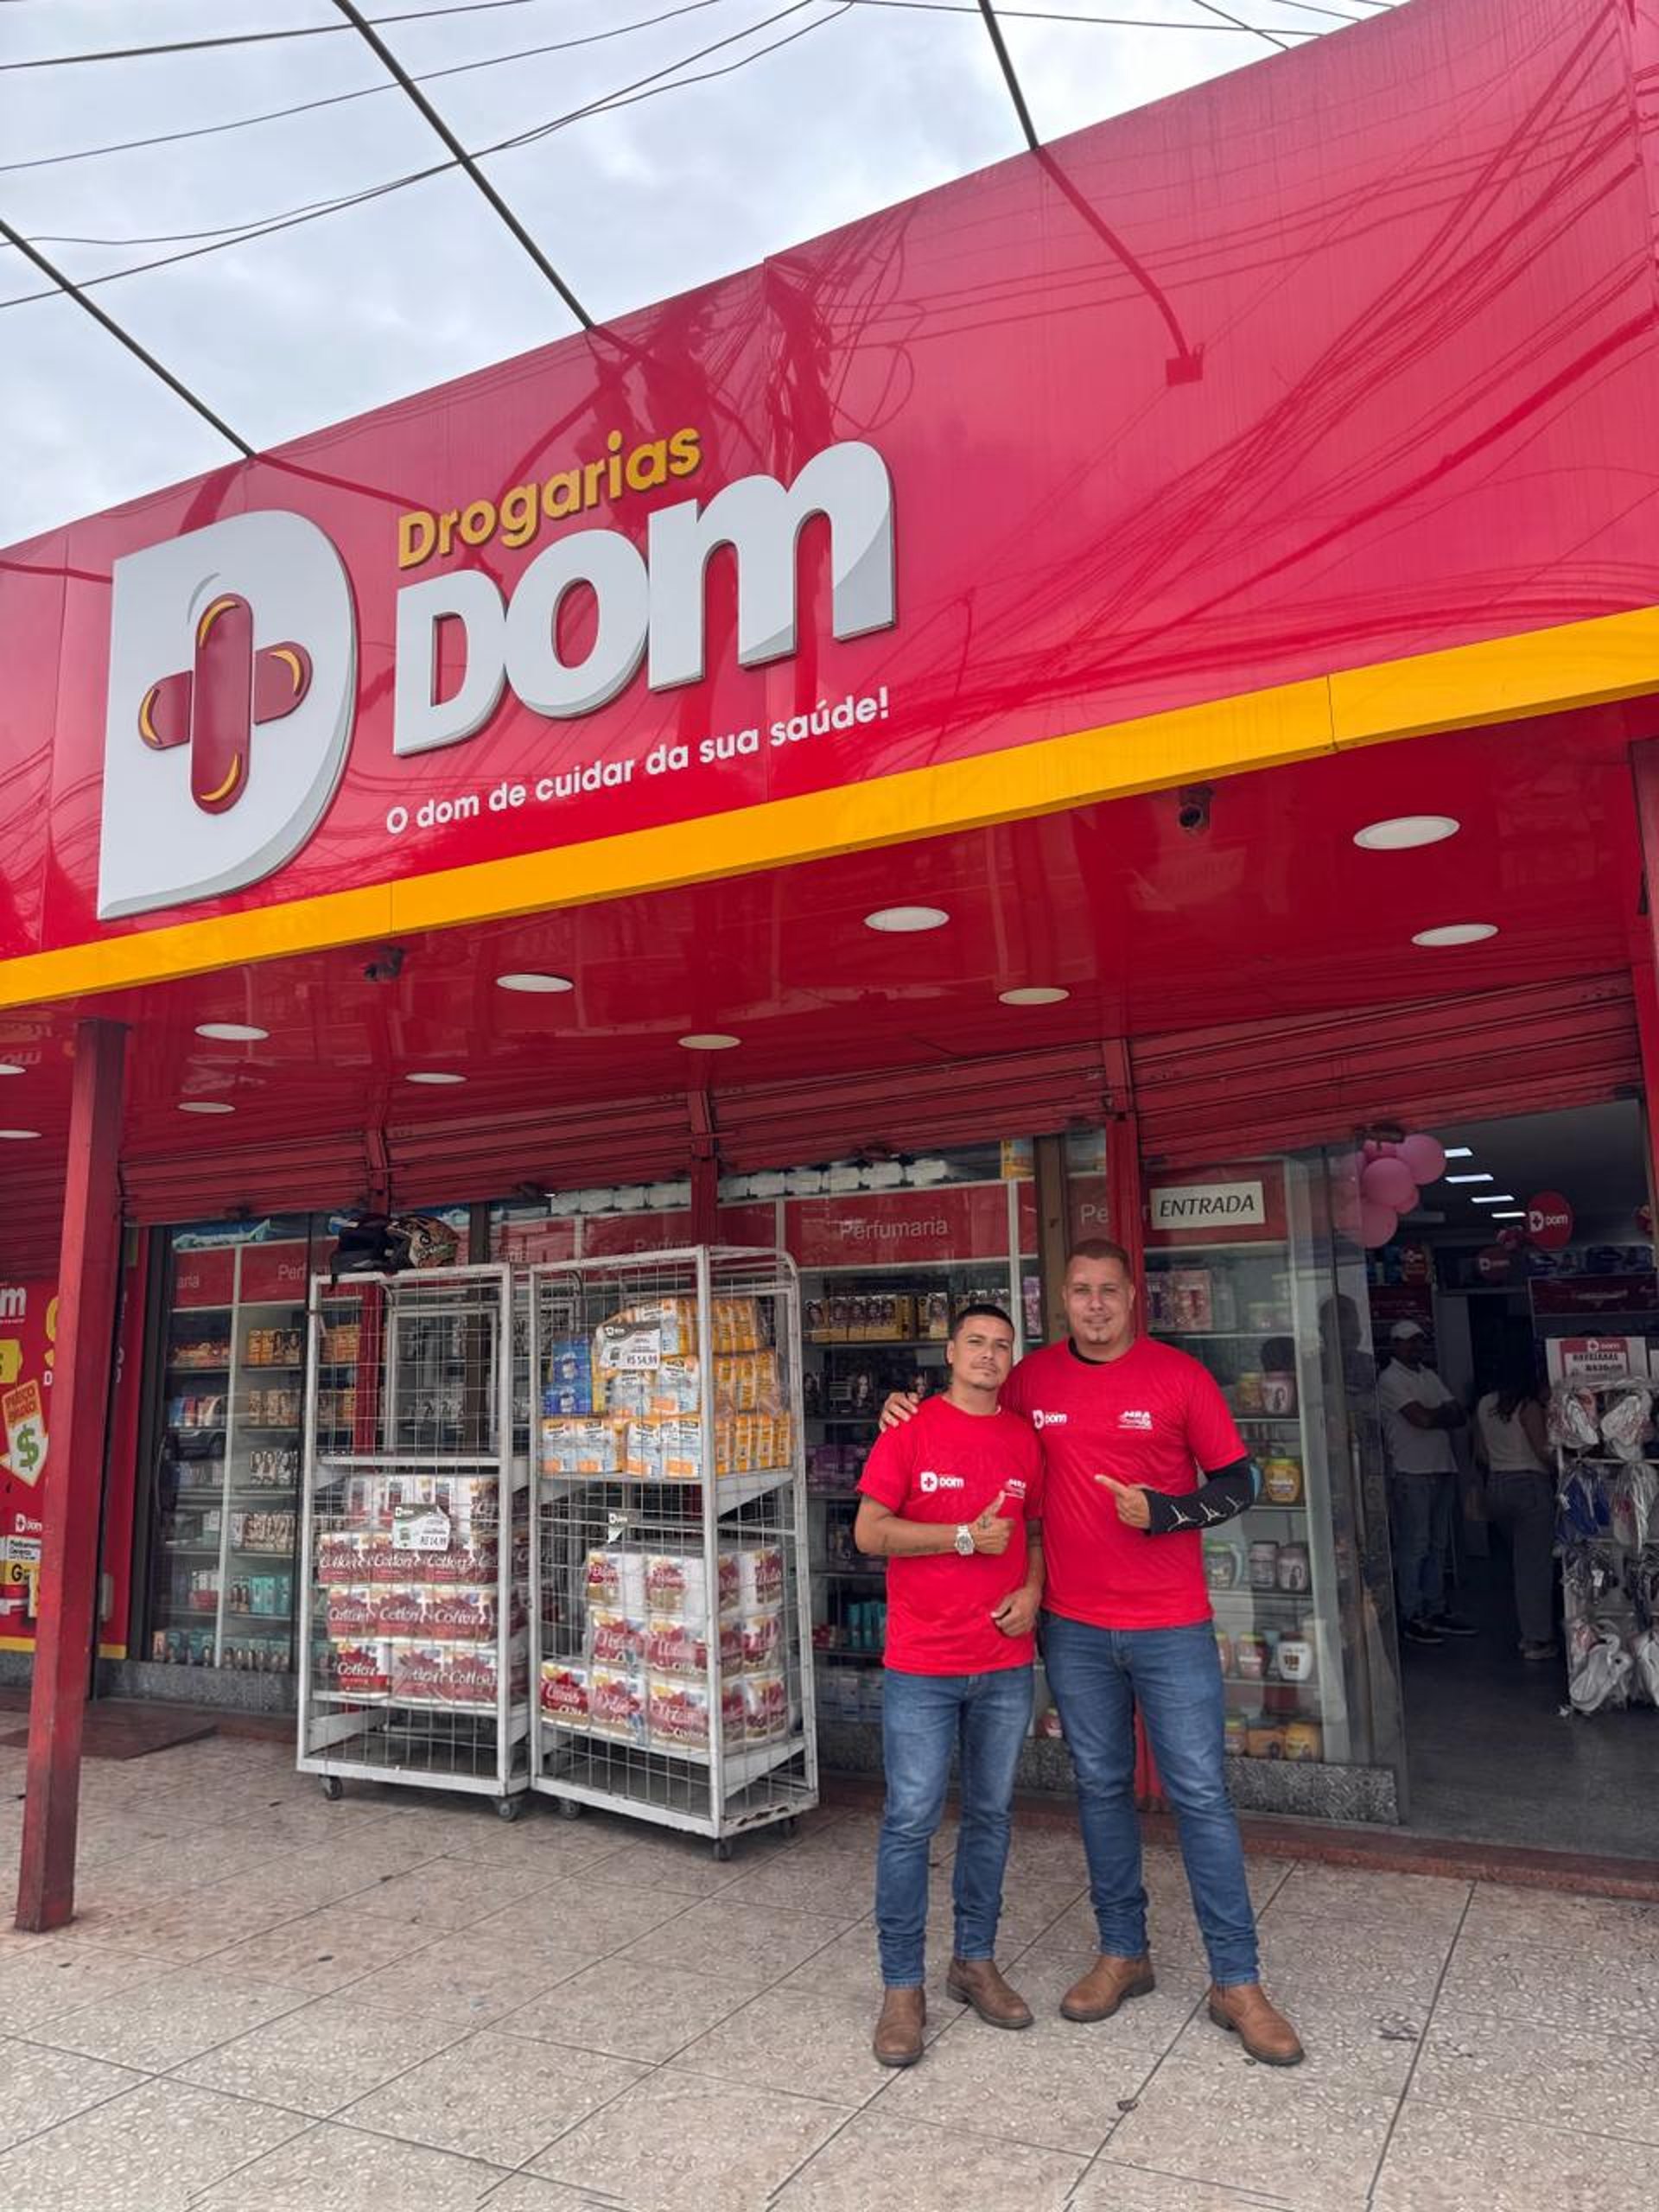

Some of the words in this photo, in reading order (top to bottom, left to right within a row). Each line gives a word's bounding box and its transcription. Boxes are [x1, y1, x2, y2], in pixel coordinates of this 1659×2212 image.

[397, 426, 702, 569] Drogarias
[386, 806, 409, 834] O
[416, 795, 480, 830] dom
[488, 781, 526, 813] de
[535, 755, 635, 801] cuidar
[645, 743, 690, 775] da
[699, 727, 760, 764] sua
[770, 687, 890, 747] saúde!
[840, 1216, 948, 1240] Perfumaria
[1160, 1194, 1255, 1218] ENTRADA
